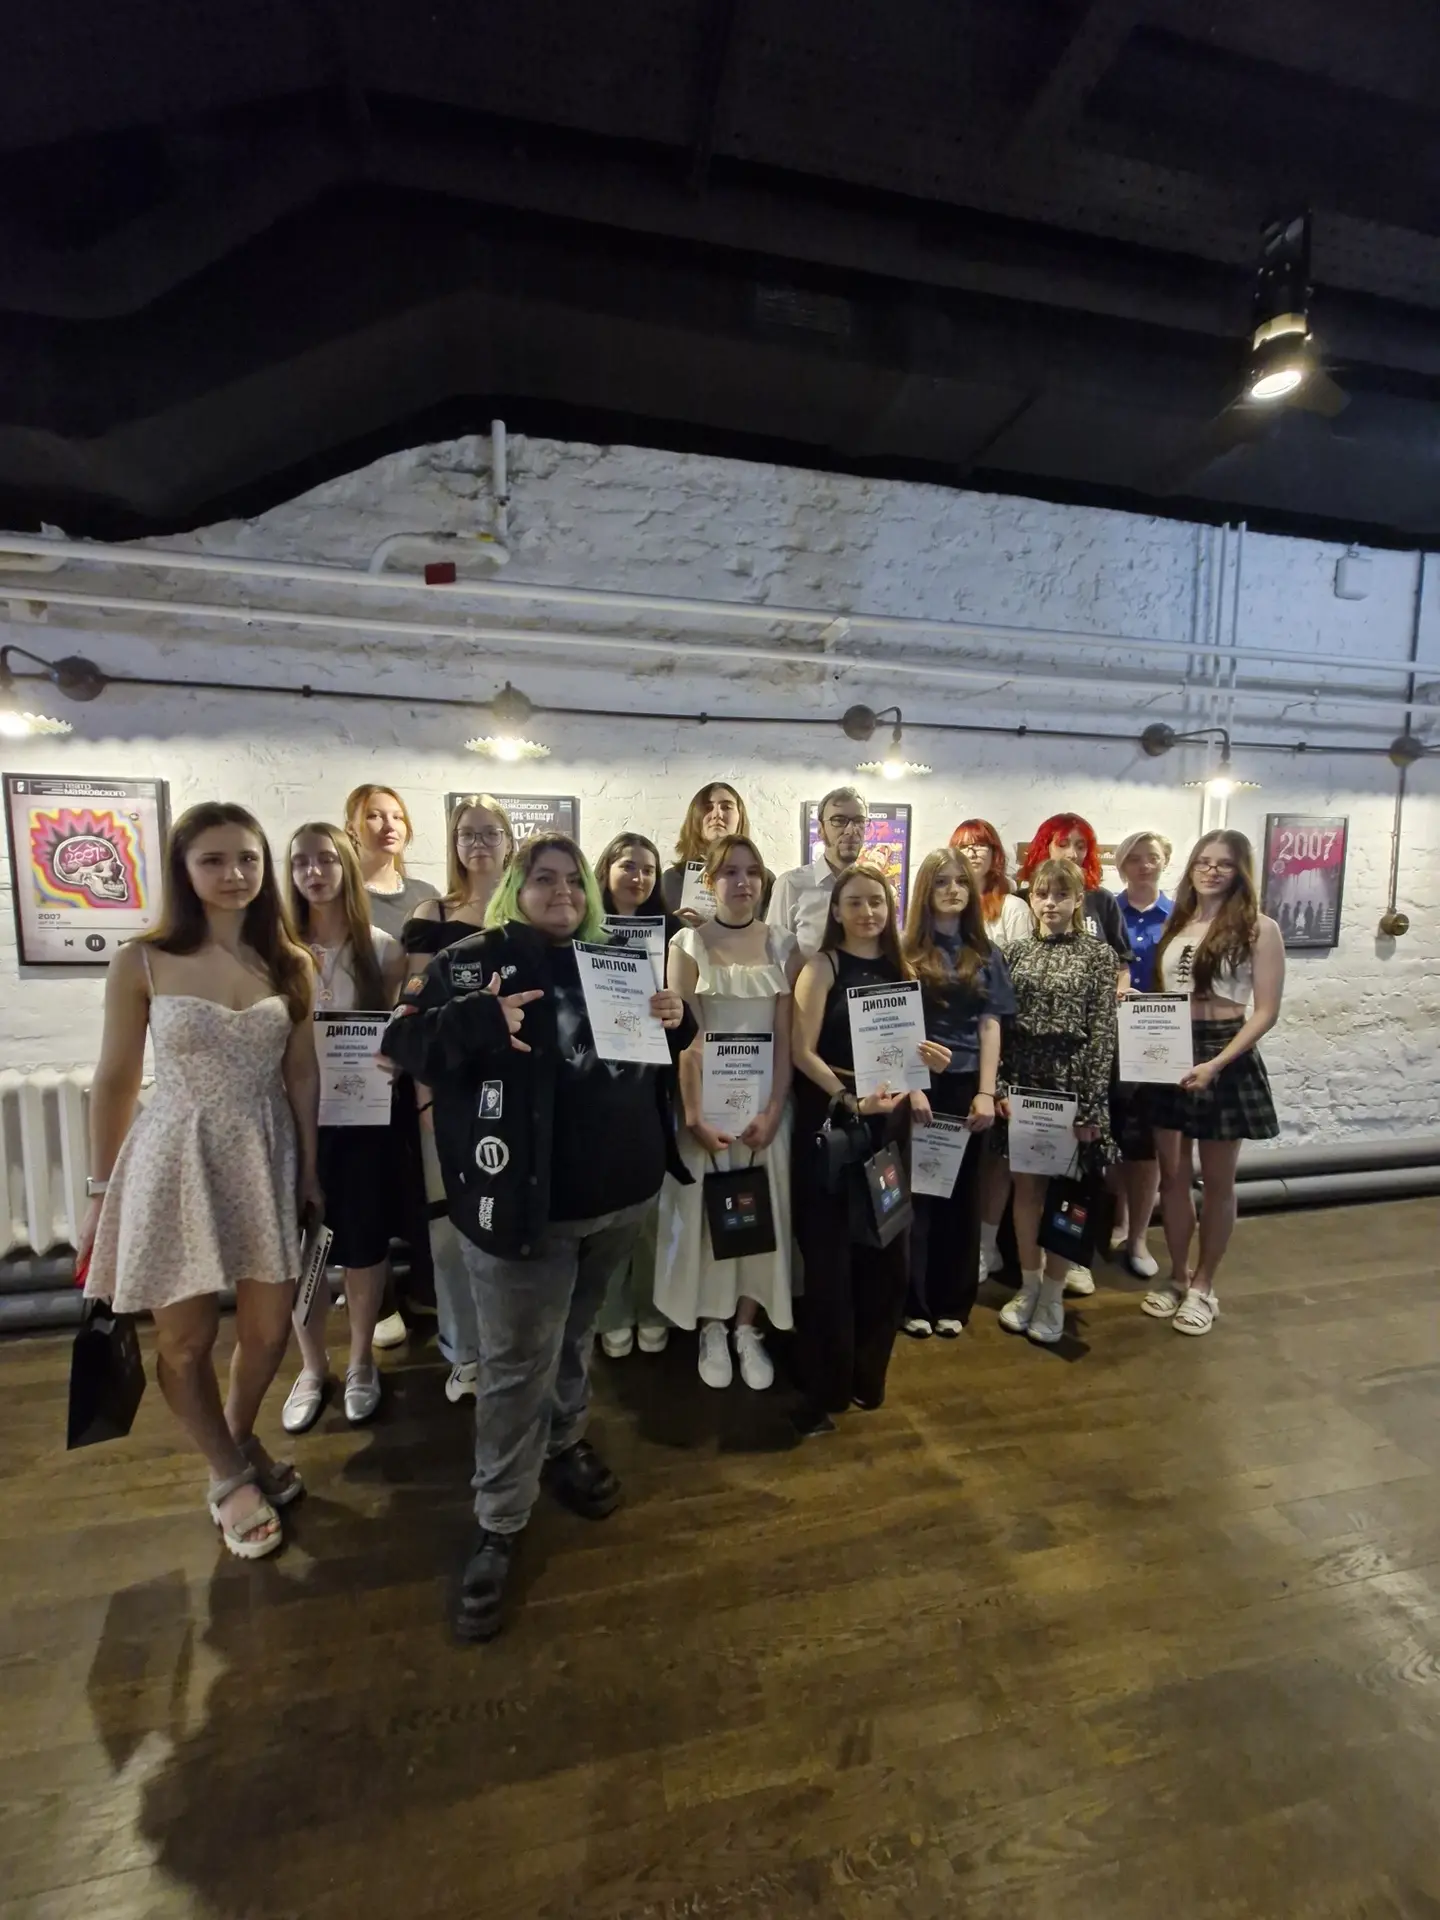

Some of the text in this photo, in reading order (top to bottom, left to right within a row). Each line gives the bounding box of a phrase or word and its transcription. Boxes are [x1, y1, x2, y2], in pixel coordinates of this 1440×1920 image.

[502, 802, 549, 811] аяковского
[1279, 831, 1338, 861] 2007
[591, 957, 637, 973] ДИПЛОМ
[862, 996, 907, 1013] ДИПЛОМ
[1132, 1004, 1176, 1014] ДИПЛОМ
[326, 1025, 378, 1038] ДИПЛОМ
[717, 1045, 760, 1057] ДИПЛОМ
[1022, 1099, 1064, 1112] ДИПЛОМ
[924, 1121, 961, 1133] ДИПЛОМ
